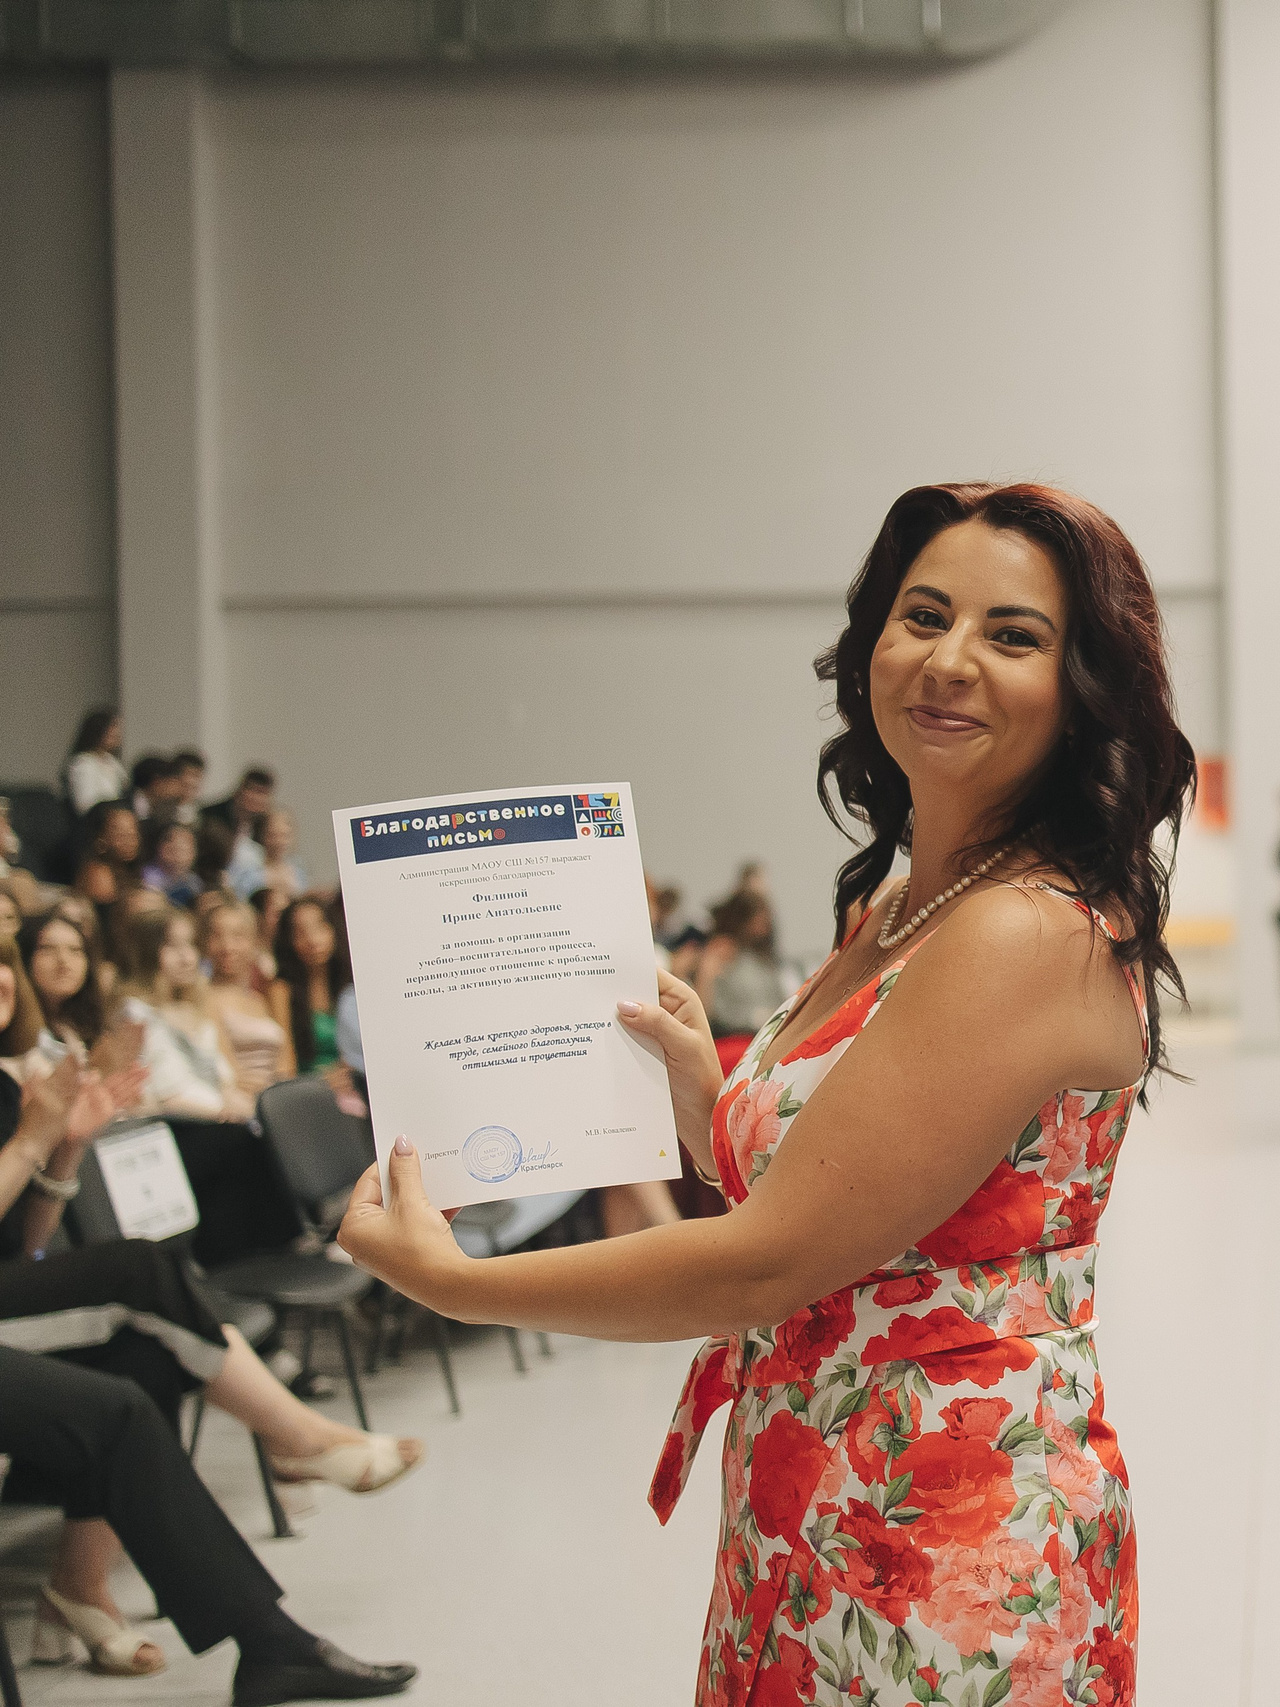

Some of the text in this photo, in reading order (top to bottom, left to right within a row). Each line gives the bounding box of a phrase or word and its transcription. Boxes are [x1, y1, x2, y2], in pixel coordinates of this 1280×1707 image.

[360, 803, 566, 838] Благодарственное
[427, 828, 506, 848] письмо
[399, 854, 592, 881] Администрация МАОУ СШ №157 выражает
[439, 869, 556, 888] искреннюю благодарность
[472, 889, 528, 903] Филиной
[441, 903, 562, 924] Ирине Анатольевне
[440, 942, 451, 950] за
[454, 937, 495, 949] помощь
[506, 929, 571, 944] организации
[549, 941, 596, 953] процесса,
[406, 966, 487, 984] неравнодушное
[489, 960, 546, 972] отношение
[557, 953, 610, 966] проблемам
[404, 967, 616, 999] школы, за активную жизненную позицию
[423, 1038, 461, 1050] Желаем
[464, 1034, 485, 1044] Вам
[487, 1028, 528, 1043] крепкого
[530, 1023, 572, 1037] здоровья,
[573, 1021, 605, 1033] успехов
[449, 1035, 593, 1061] труде, семейного благополучия,
[462, 1057, 518, 1070] оптимизма
[528, 1049, 588, 1062] процветания
[603, 1125, 637, 1135] Коваленко
[424, 1148, 459, 1161] Директор
[520, 1162, 563, 1173] Красноярск
